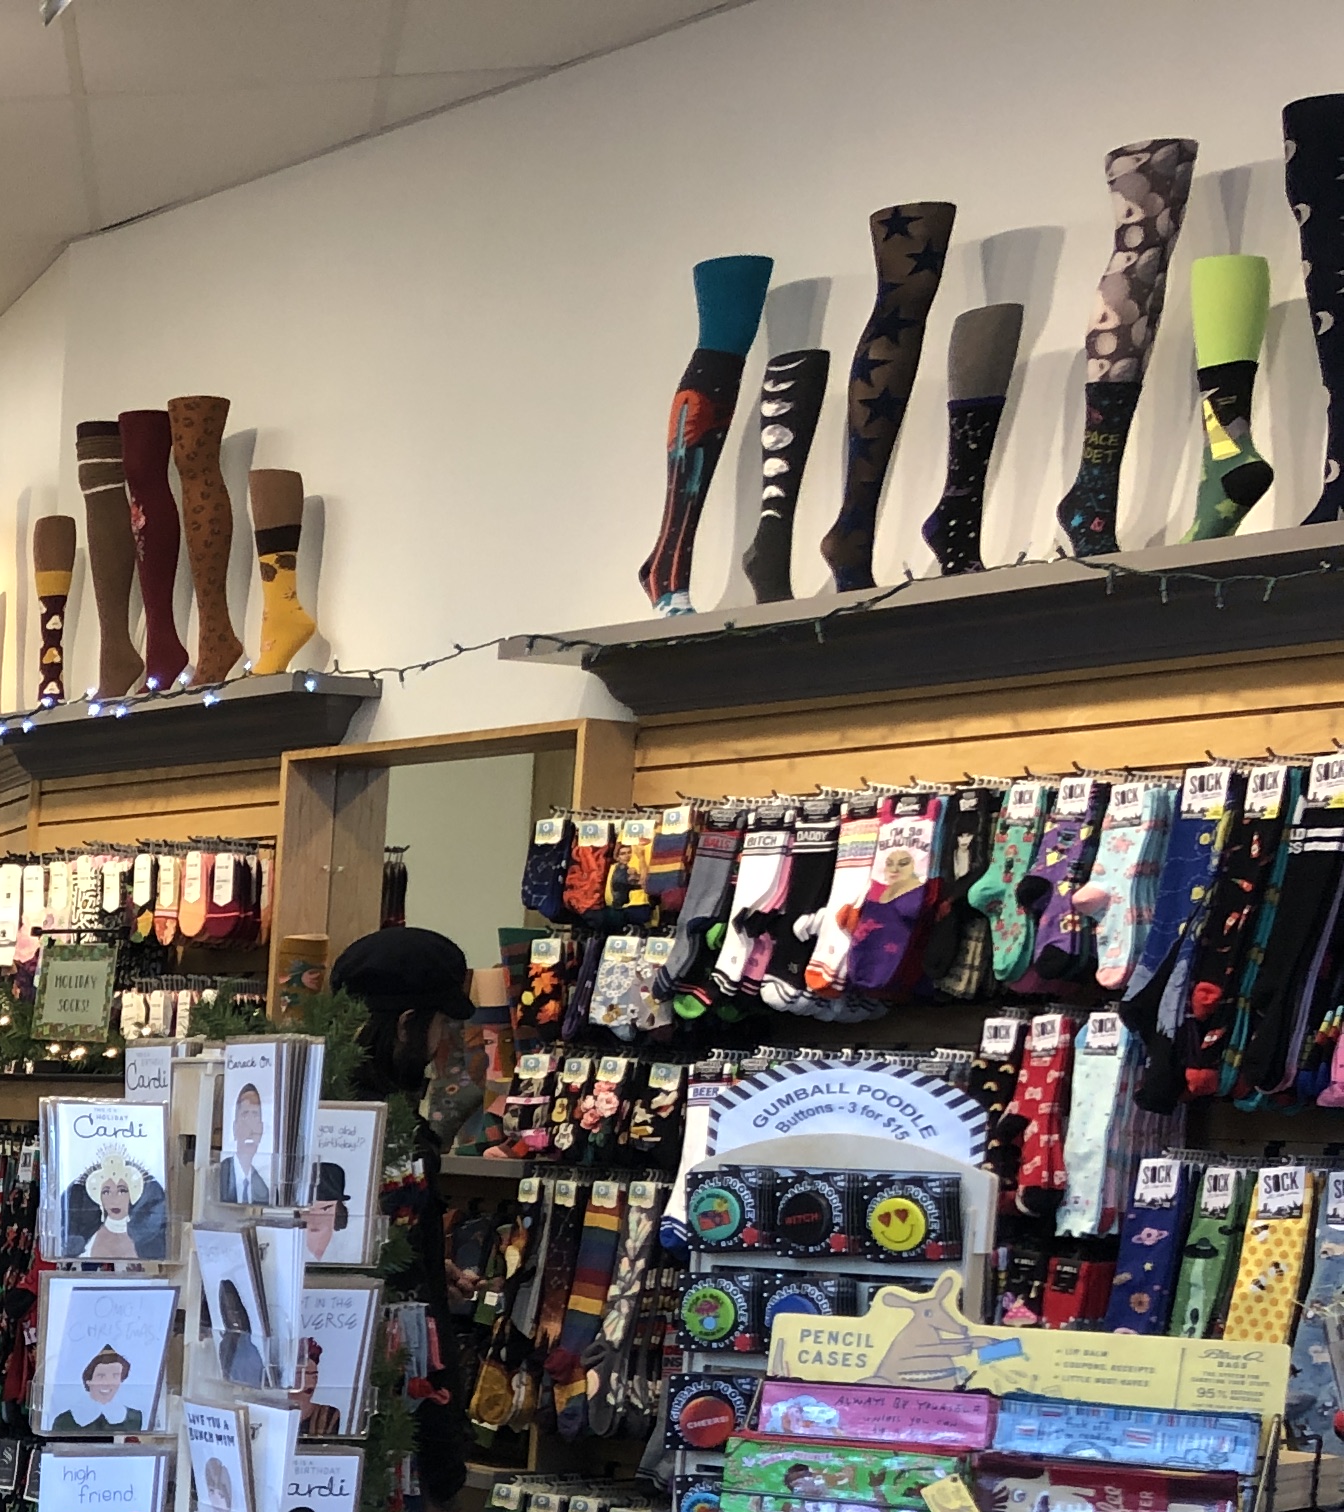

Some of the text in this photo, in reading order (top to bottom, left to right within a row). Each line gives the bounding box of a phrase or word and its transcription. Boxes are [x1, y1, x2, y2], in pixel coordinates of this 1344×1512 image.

[746, 835, 777, 847] BITCH
[796, 831, 829, 842] DADDY
[55, 975, 97, 989] HOLIDAY
[57, 999, 89, 1013] SOCKS!
[127, 1060, 168, 1091] Cardi
[692, 1087, 720, 1097] BEER
[752, 1083, 938, 1139] GUMBALL POODLE
[73, 1113, 148, 1138] Cardi
[775, 1103, 834, 1133] Buttons
[848, 1102, 856, 1114] 3
[860, 1105, 883, 1121] for
[882, 1116, 911, 1141] $15
[1142, 1165, 1172, 1184] SOCK
[1206, 1173, 1229, 1193] SOCK
[1263, 1171, 1299, 1194] SOCK
[801, 1284, 833, 1315] POODL
[800, 1328, 875, 1349] PENCIL
[798, 1350, 868, 1369] CASES
[62, 1465, 96, 1484] high
[288, 1478, 350, 1497] ardi
